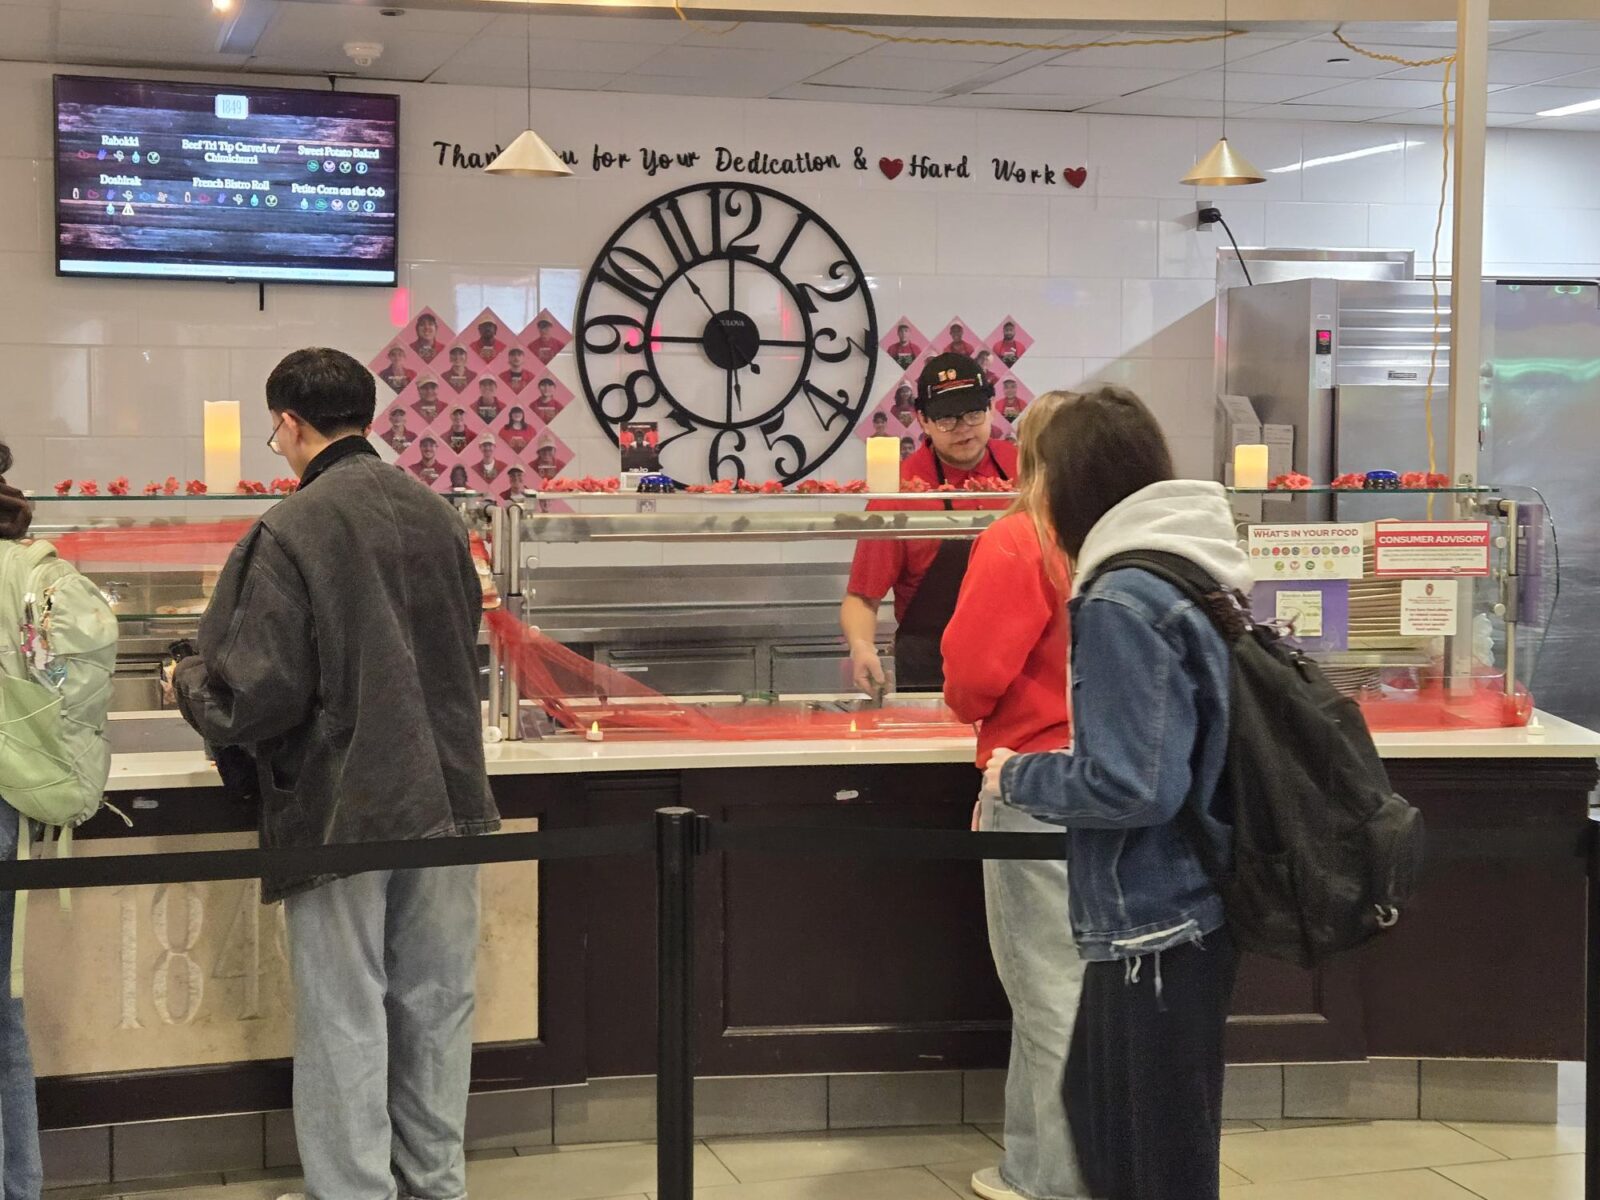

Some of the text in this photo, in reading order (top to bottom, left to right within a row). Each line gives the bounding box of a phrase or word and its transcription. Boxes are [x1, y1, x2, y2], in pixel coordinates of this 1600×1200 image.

[222, 99, 242, 115] 1849
[182, 139, 281, 155] Beef Tri Tip Carved w/
[204, 152, 258, 164] Chimichurri
[298, 145, 380, 159] Sweet Potato Baked
[593, 143, 631, 172] for
[640, 147, 700, 176] Your
[715, 147, 841, 174] Dedication
[853, 146, 868, 170] &
[909, 154, 970, 179] Hard
[991, 158, 1056, 185] Work
[192, 177, 270, 191] French Bistro Roll
[291, 183, 386, 198] Petite Corn on the Cob
[648, 196, 700, 269] 11
[706, 185, 763, 255] 12
[775, 210, 813, 275] 1
[597, 245, 665, 307] 10
[794, 259, 859, 314] 2
[583, 314, 647, 355] 9
[813, 326, 872, 363] 3
[597, 369, 662, 425] 8
[801, 378, 858, 432] 4
[708, 428, 746, 489] 6
[759, 408, 808, 478] 5
[1253, 528, 1359, 538] WHAT'S IN YOUR FOOD
[1379, 535, 1486, 544] CONSUMER ADVISORY
[115, 878, 295, 1030] 184
